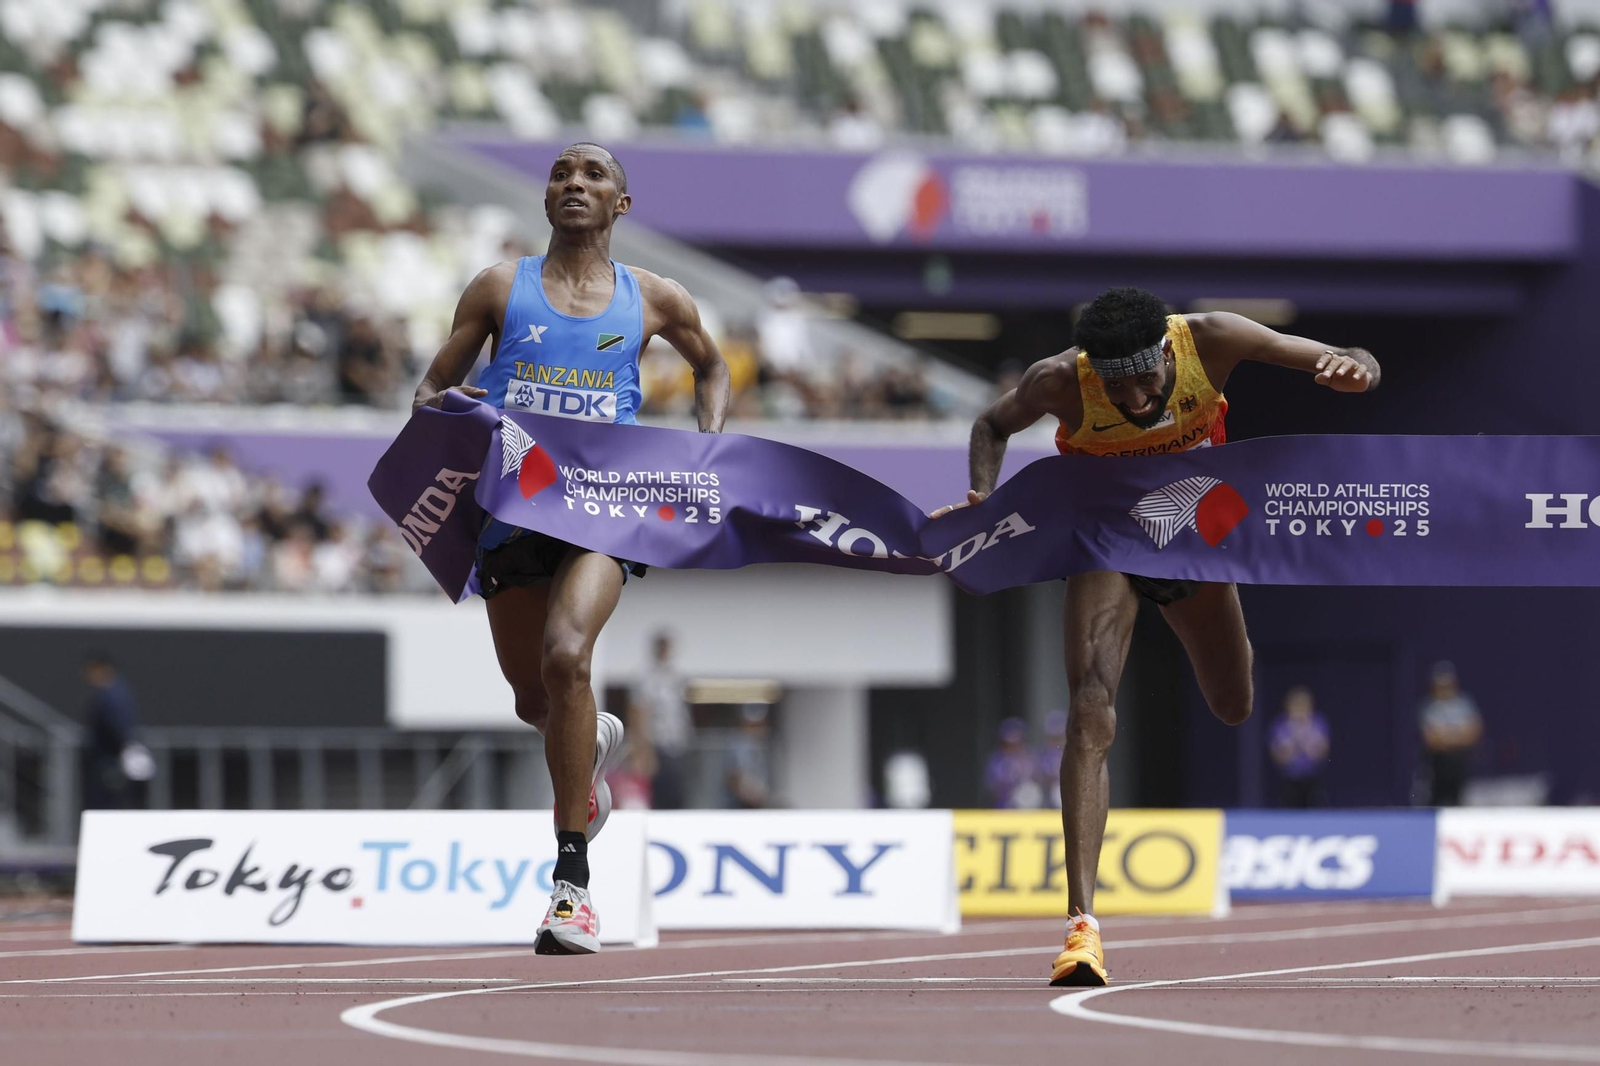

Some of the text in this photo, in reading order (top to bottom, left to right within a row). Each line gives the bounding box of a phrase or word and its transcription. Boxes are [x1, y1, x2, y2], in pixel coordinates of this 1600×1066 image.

[514, 360, 615, 389] TANZANIA
[535, 387, 609, 418] TDK
[559, 465, 720, 486] WORLD ATHLETICS
[566, 480, 721, 504] CHAMPIONSHIPS
[1265, 483, 1430, 498] WORLD ATHLETICS
[1264, 500, 1430, 517] CHAMPIONSHIPS
[147, 837, 355, 927] Tokyo
